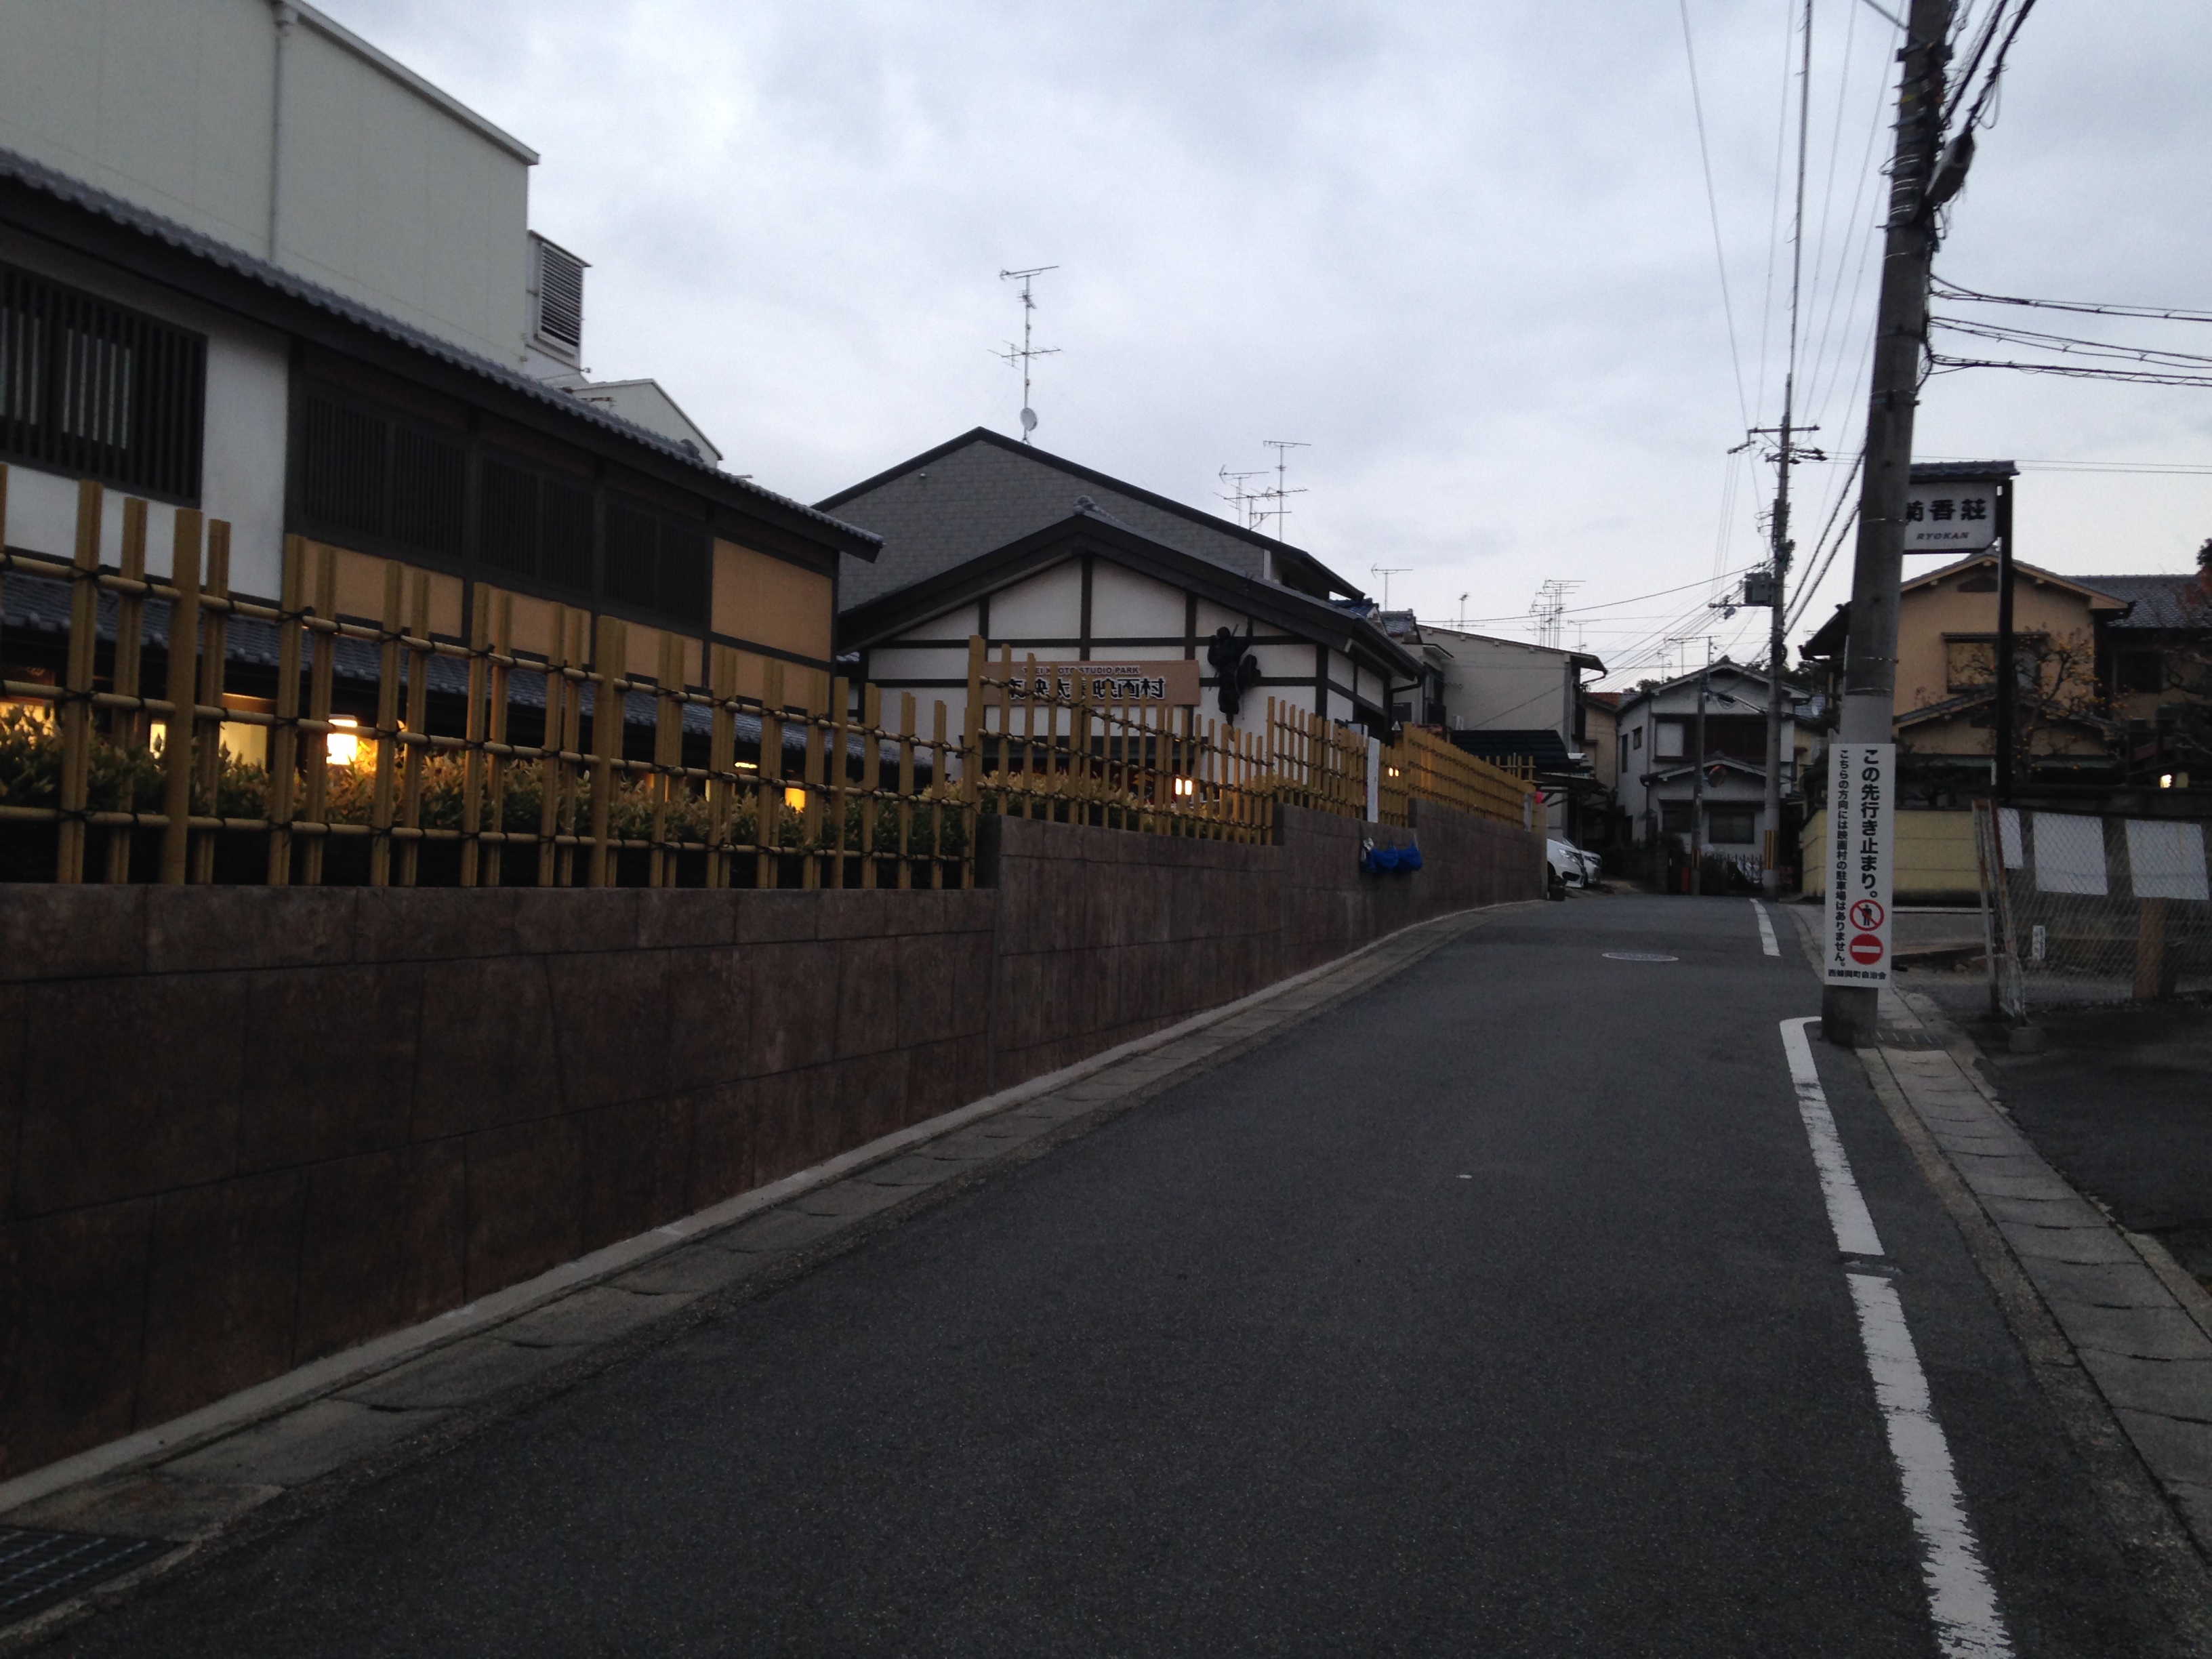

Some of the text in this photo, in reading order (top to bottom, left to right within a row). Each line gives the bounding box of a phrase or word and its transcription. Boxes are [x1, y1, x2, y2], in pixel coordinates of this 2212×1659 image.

[1916, 531, 1969, 540] RYOKAN
[1023, 667, 1043, 675] TEI
[1046, 667, 1075, 675] KOTO
[1860, 749, 1880, 898] この先行き止まり。
